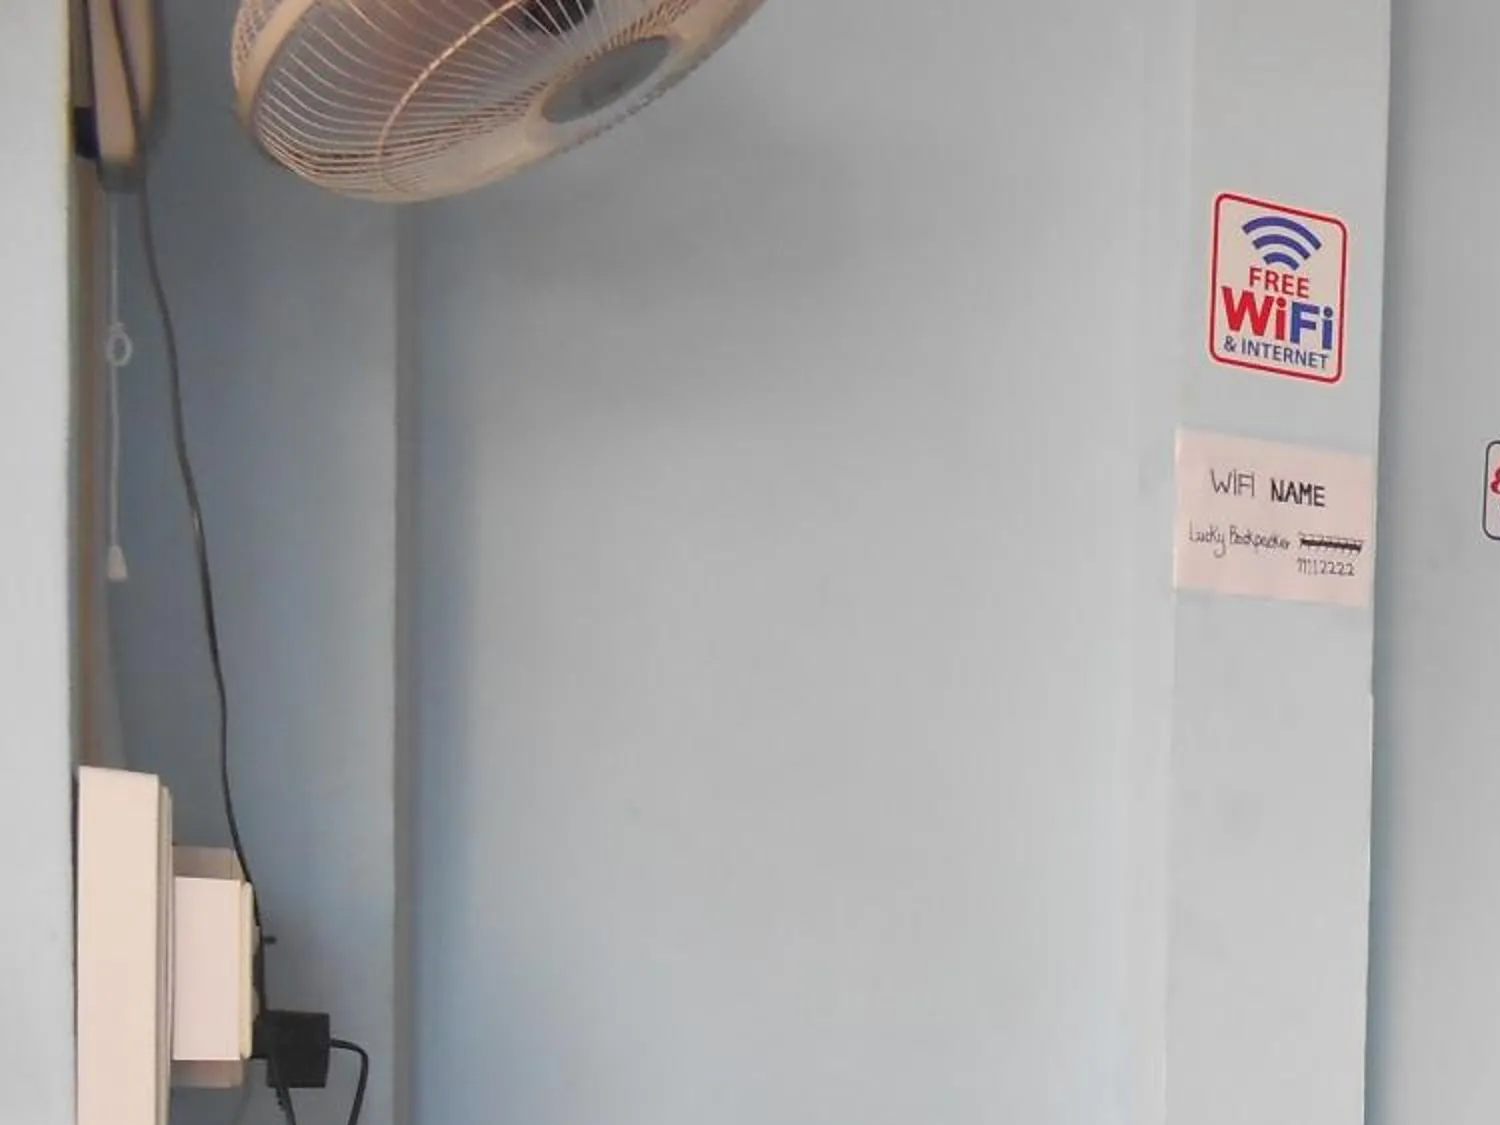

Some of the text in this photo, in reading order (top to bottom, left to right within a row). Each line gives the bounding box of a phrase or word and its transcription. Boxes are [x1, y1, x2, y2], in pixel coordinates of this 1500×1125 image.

[1249, 266, 1310, 298] FREE
[1221, 286, 1334, 351] WiFi
[1224, 335, 1329, 370] & INTERNET
[1270, 477, 1326, 508] NAME
